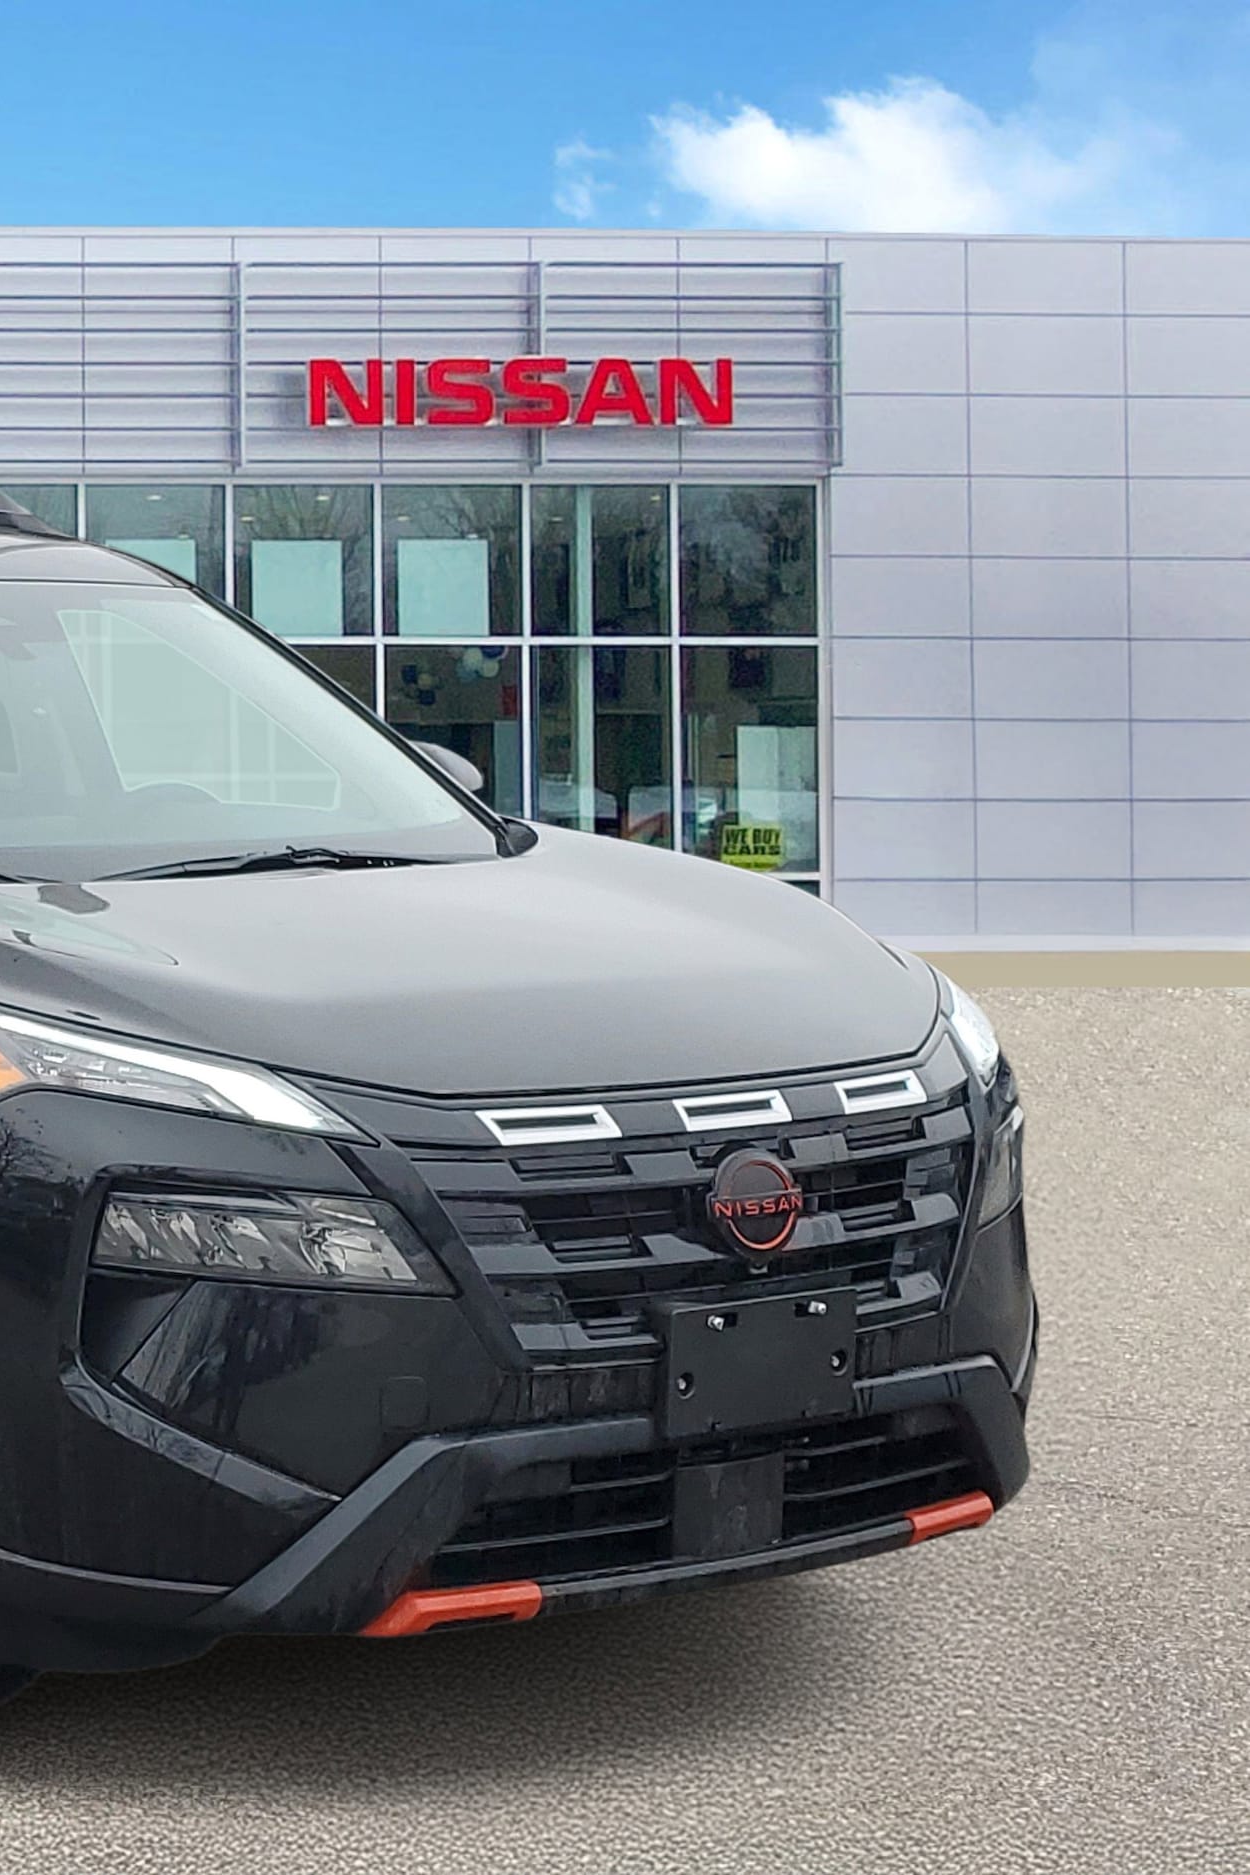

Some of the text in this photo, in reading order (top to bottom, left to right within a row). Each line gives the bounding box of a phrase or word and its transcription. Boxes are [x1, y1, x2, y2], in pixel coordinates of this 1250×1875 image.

[307, 357, 734, 429] NISSAN
[725, 828, 782, 845] WE BUY
[723, 845, 781, 856] CARS
[713, 1195, 803, 1218] NISSAN
